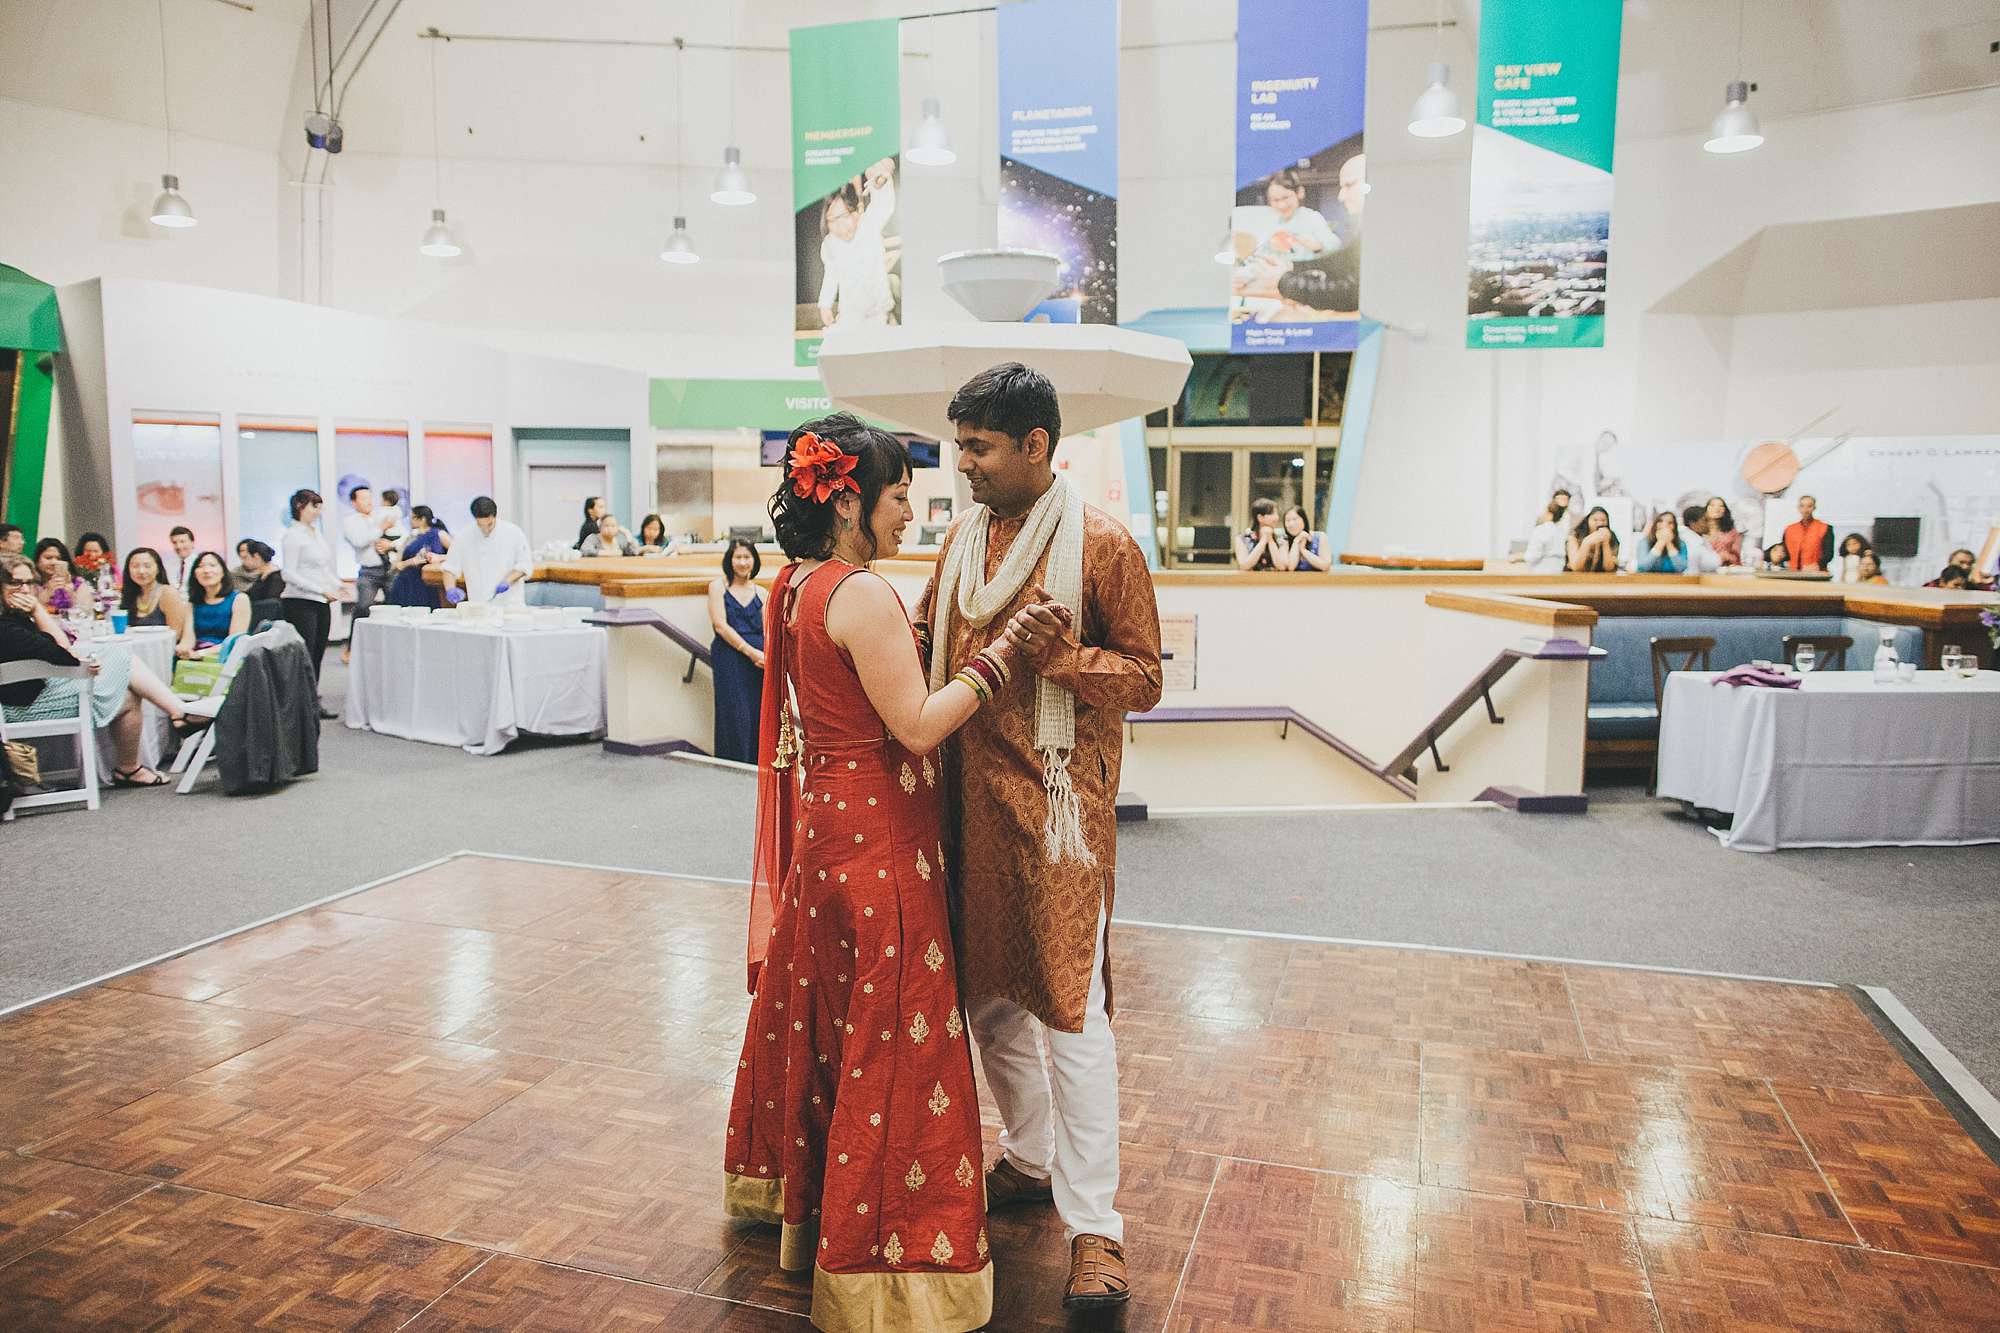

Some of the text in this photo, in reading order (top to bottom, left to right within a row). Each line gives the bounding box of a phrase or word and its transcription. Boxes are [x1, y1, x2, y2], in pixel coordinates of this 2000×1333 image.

[1495, 62, 1562, 77] BAY VIEW
[1251, 77, 1319, 92] INGENUITY
[1494, 78, 1531, 91] CAFE
[1251, 92, 1278, 105] LAB
